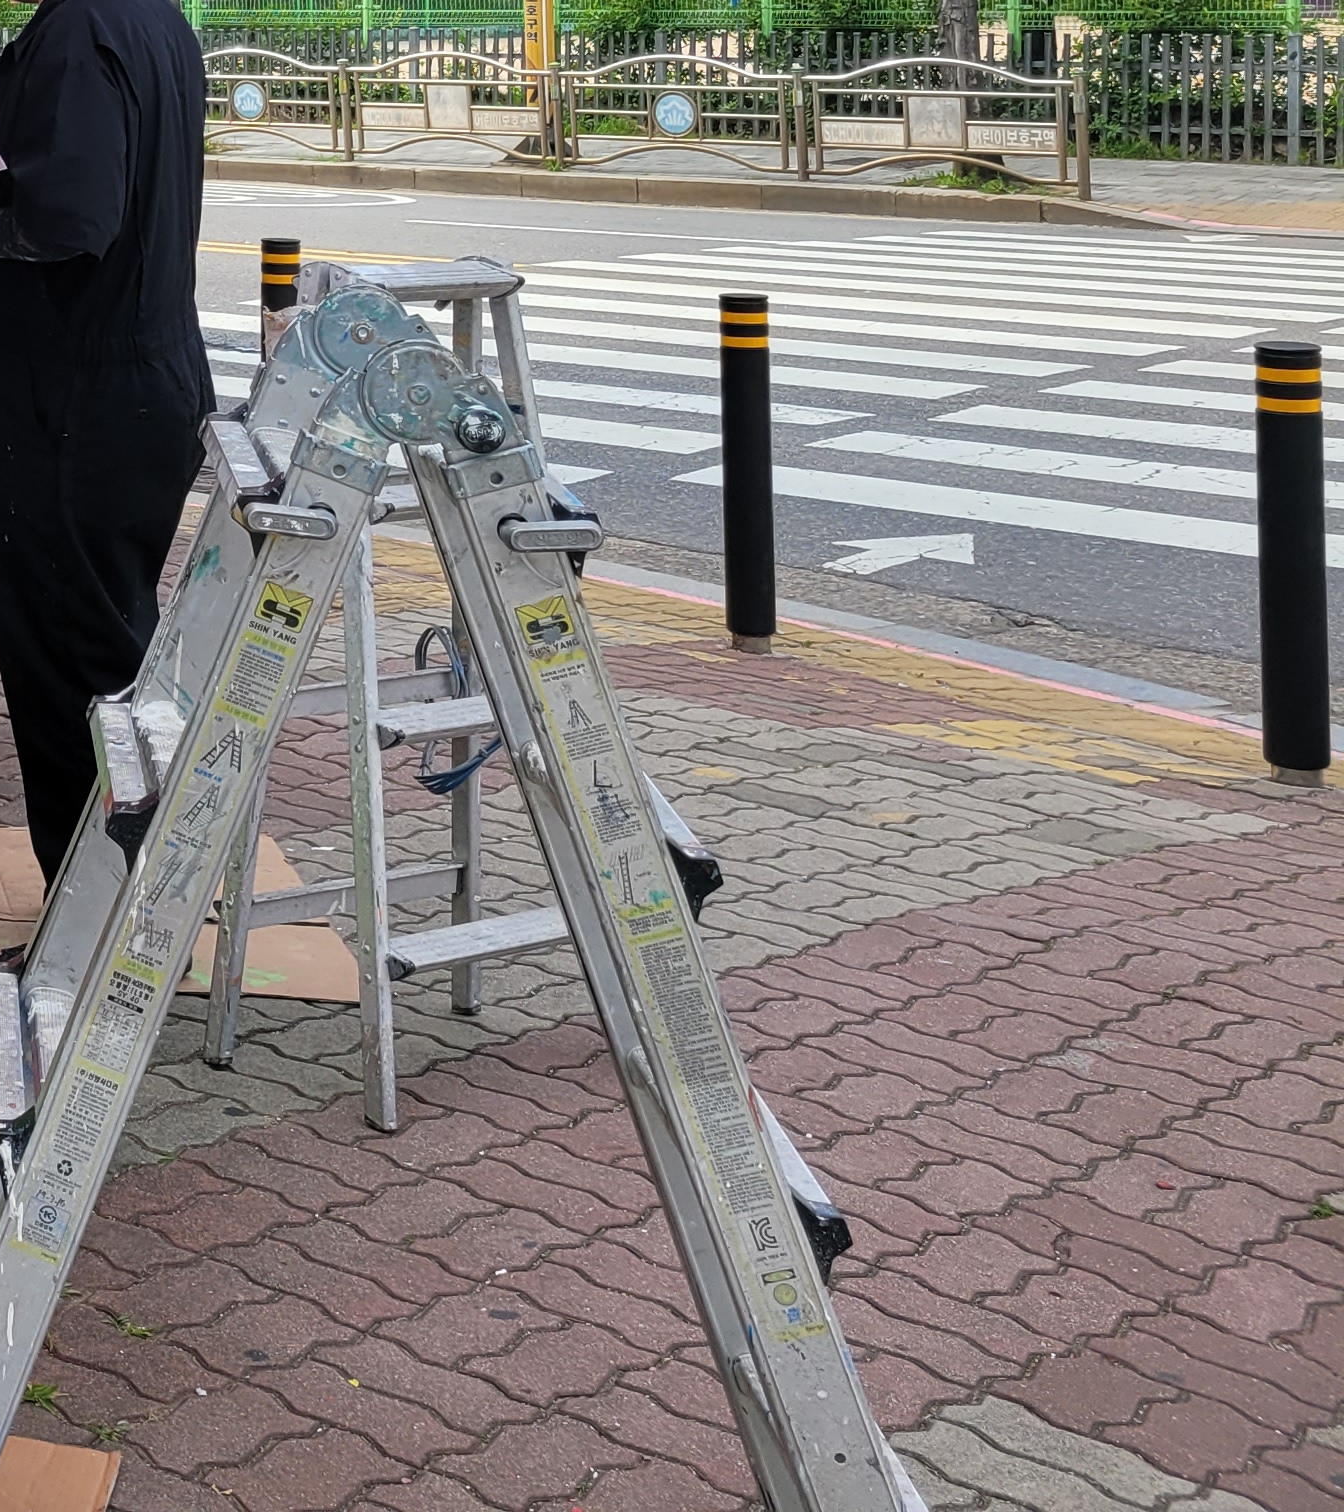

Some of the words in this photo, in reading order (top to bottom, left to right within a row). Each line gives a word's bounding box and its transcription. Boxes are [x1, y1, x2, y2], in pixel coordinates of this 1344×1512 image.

[970, 128, 1057, 150] 어린이보호구역
[249, 620, 270, 634] SHIN
[272, 629, 298, 645] YANG
[552, 638, 580, 652] YANG
